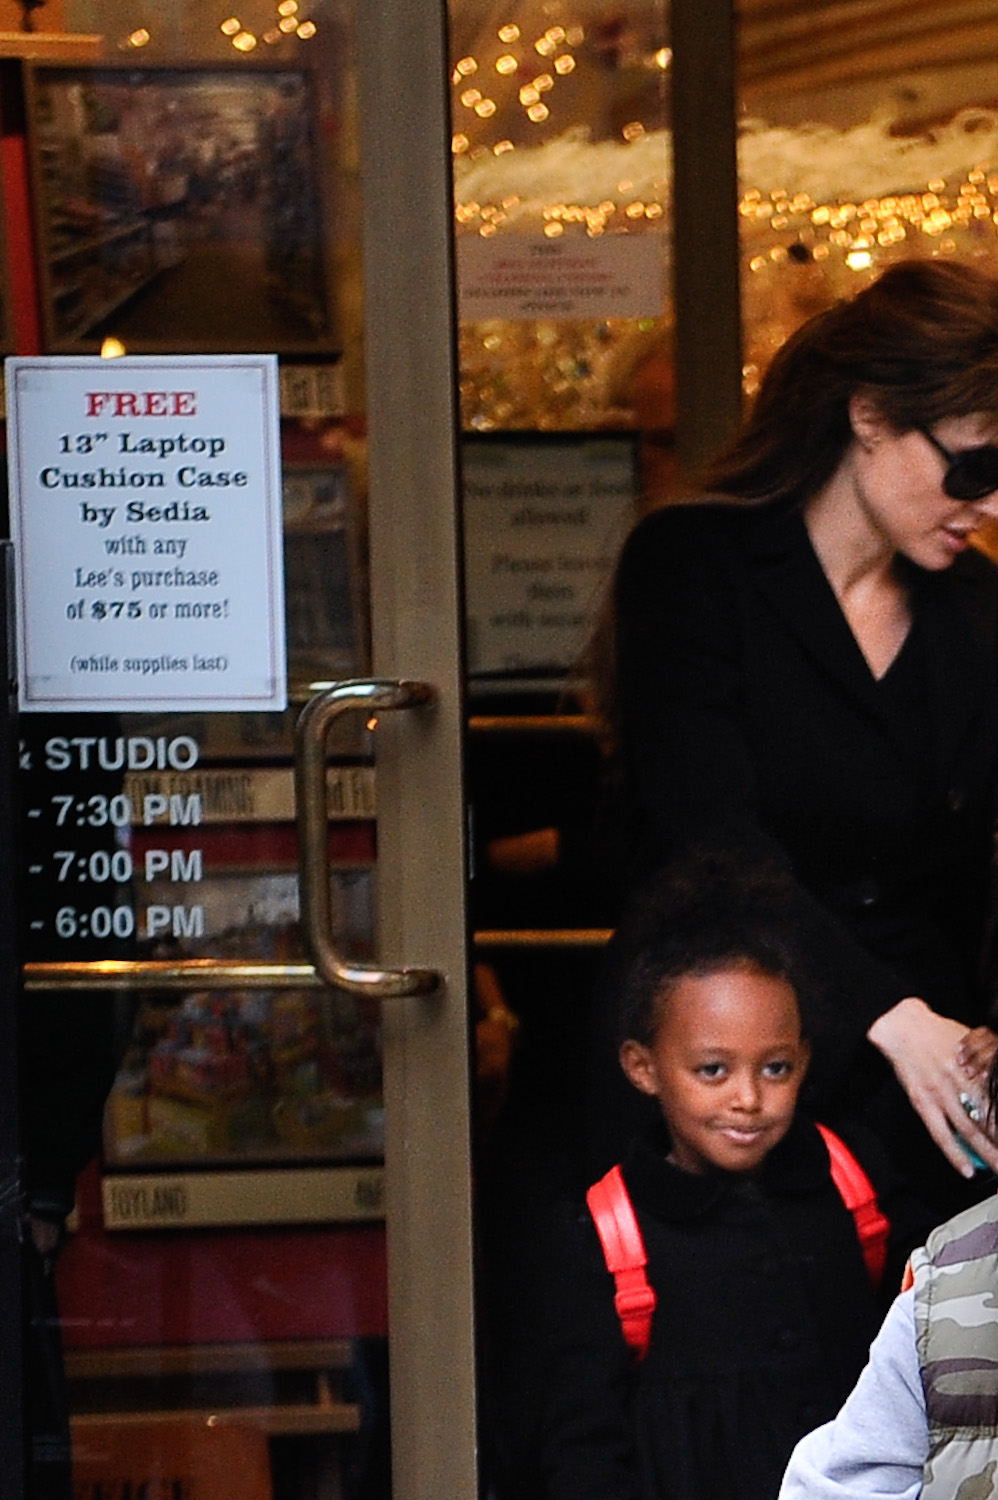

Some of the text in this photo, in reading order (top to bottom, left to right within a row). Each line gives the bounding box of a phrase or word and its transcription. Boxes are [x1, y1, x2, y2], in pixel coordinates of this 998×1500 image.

[85, 392, 197, 417] FREE
[119, 432, 226, 457] Laptop
[40, 466, 248, 489] Cushion Case
[81, 501, 210, 528] by Sedia
[105, 535, 188, 558] with any
[131, 568, 220, 591] purchase
[66, 599, 230, 621] of $75 or more!
[70, 654, 229, 676] (while supplies last)
[44, 736, 200, 771] STUDIO
[51, 794, 132, 827] 7:30
[143, 793, 203, 826] PM
[53, 850, 134, 883] 7:00
[145, 849, 203, 882] PM
[55, 905, 135, 938] 6:00
[146, 905, 205, 938] PM
